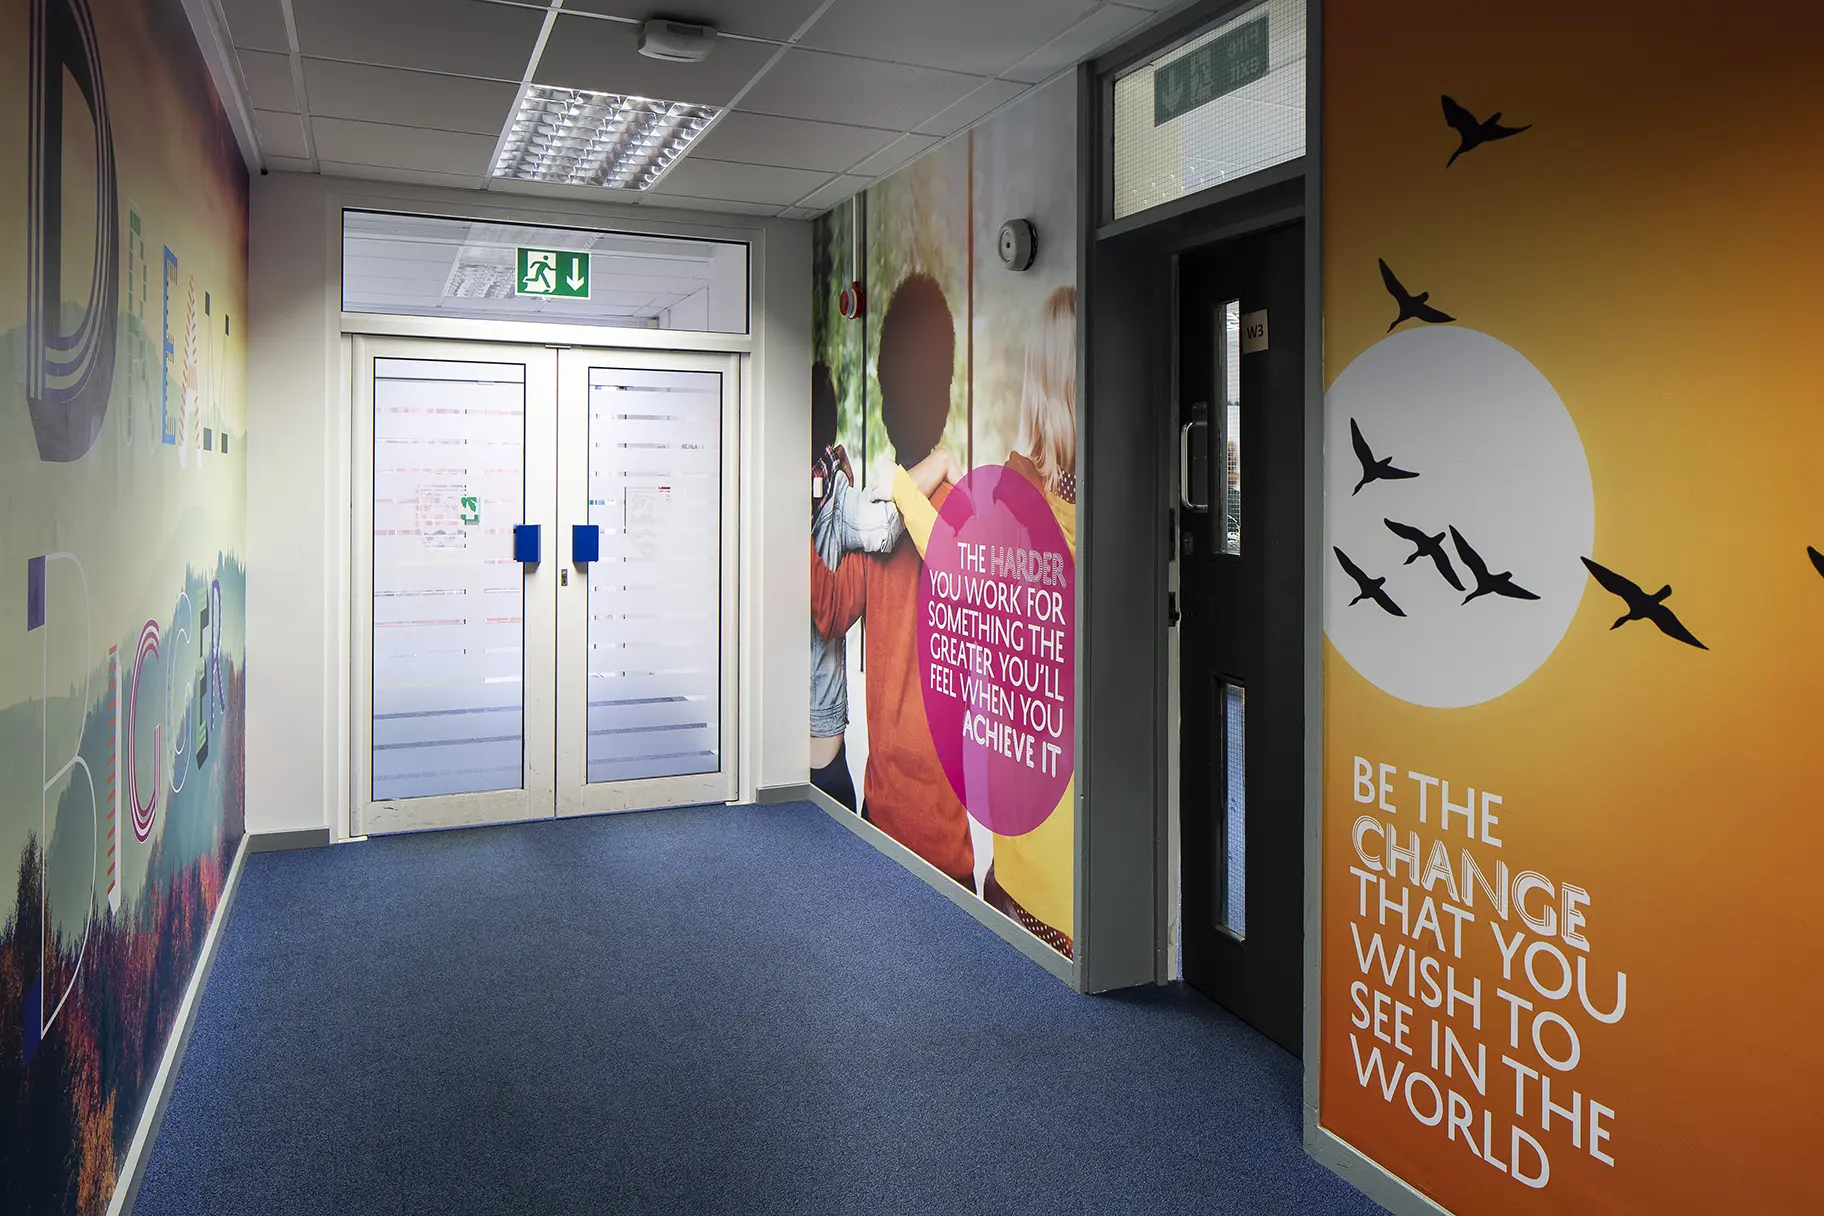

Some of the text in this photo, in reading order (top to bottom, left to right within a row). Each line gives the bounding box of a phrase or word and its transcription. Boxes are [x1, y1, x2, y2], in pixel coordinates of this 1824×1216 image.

[26, 0, 229, 470] DREAM
[1246, 324, 1264, 340] W3
[929, 569, 1066, 625] YOU WORK FOR
[957, 541, 1067, 588] THE HARDER
[928, 600, 1065, 664] SOMETHING THE
[930, 632, 1064, 702] GREATER YOU'LL
[930, 663, 1063, 738] FEEL WHEN YOU
[962, 709, 1062, 778] ACHIEVE IT
[23, 551, 225, 1065] BIGGER
[1353, 755, 1503, 848] BE THE
[1351, 814, 1591, 952] CHANGE
[1349, 865, 1627, 1024] THAT YOU
[1349, 921, 1581, 1072] WISH TO
[1349, 1032, 1550, 1189] WORLD
[1350, 981, 1616, 1168] SEE IN THE
